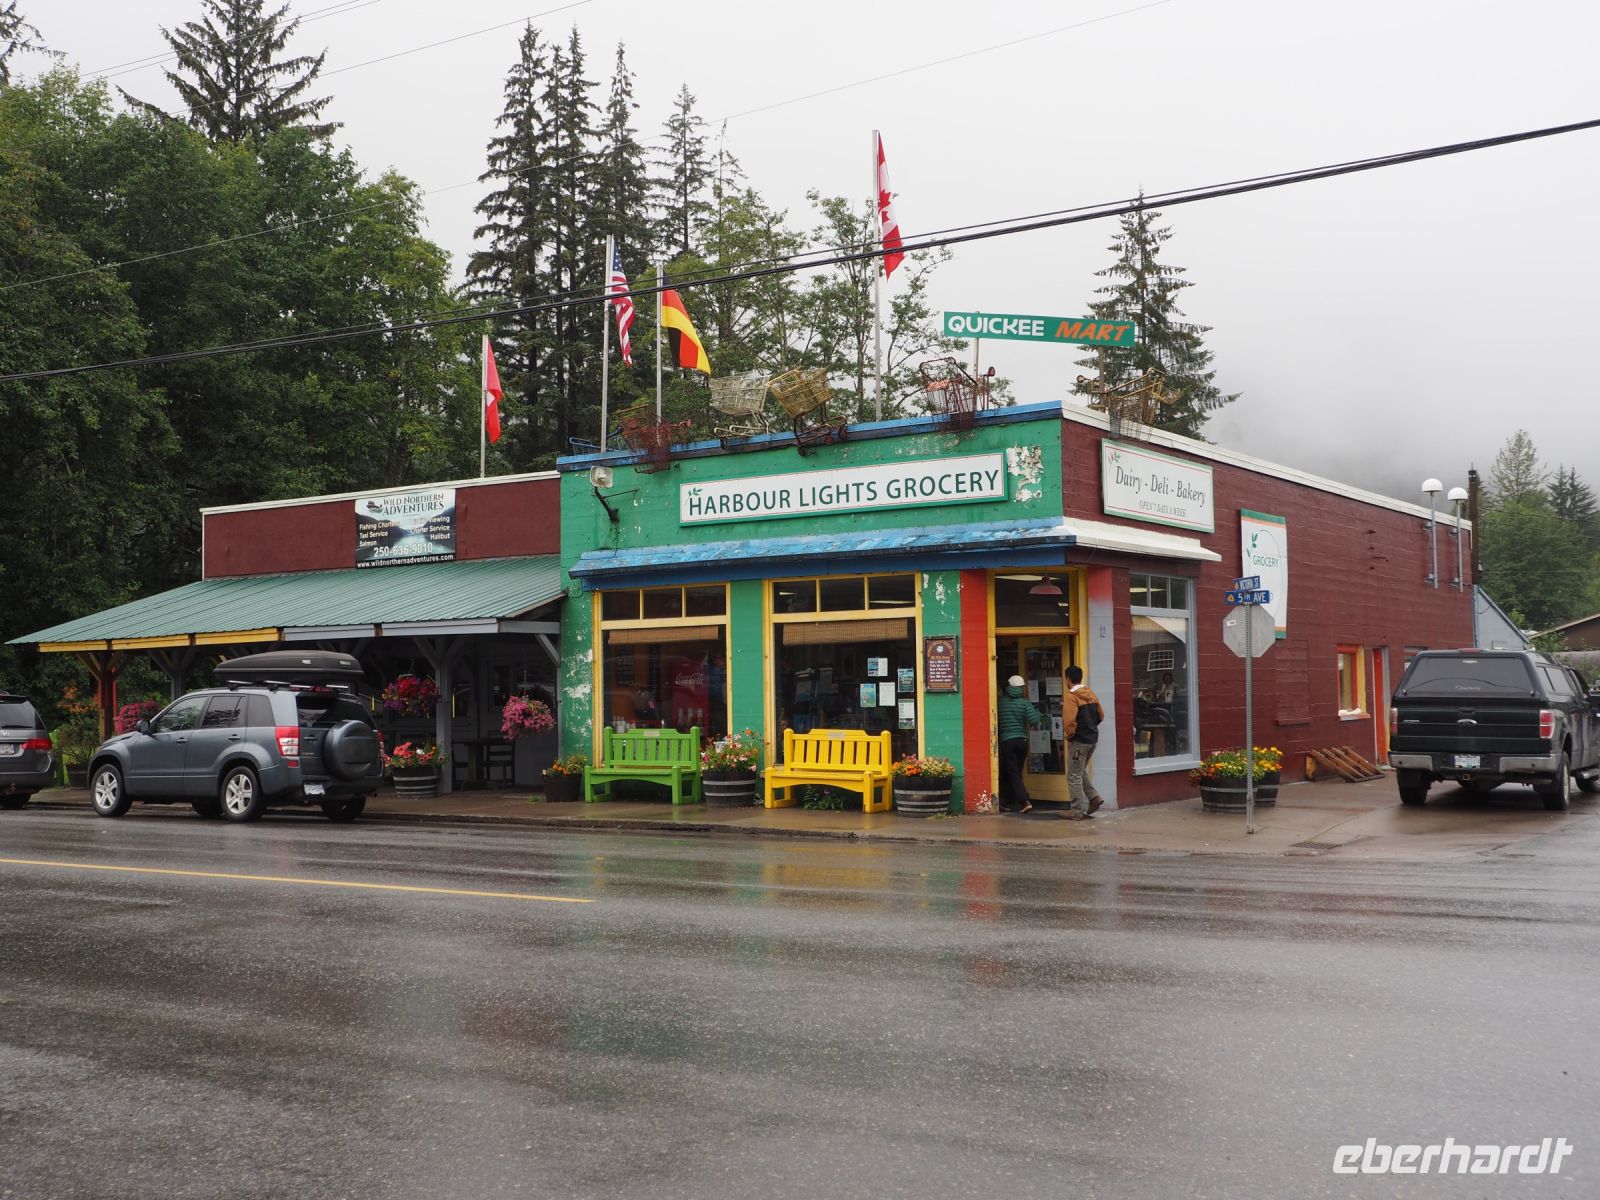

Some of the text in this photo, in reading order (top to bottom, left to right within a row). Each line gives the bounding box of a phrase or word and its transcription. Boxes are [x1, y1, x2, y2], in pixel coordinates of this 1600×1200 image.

[948, 315, 1130, 342] QUICKEE MART
[689, 469, 999, 517] HARBOUR LIGHTS GROCERY
[1115, 465, 1141, 495] Dairy
[1151, 474, 1169, 495] Deli
[1176, 480, 1206, 508] Bakery
[383, 493, 444, 506] WILD NORTHERN
[383, 501, 444, 516] ADVENTURES
[359, 523, 377, 531] Fishing
[369, 531, 388, 539] Service
[430, 533, 450, 541] Halibut
[359, 539, 377, 547] Salmon
[373, 543, 433, 558] 250-636-9010
[357, 554, 454, 568] www.wildnorthernadventures.com
[1252, 554, 1279, 568] GROCERY
[1253, 591, 1267, 603] AVE
